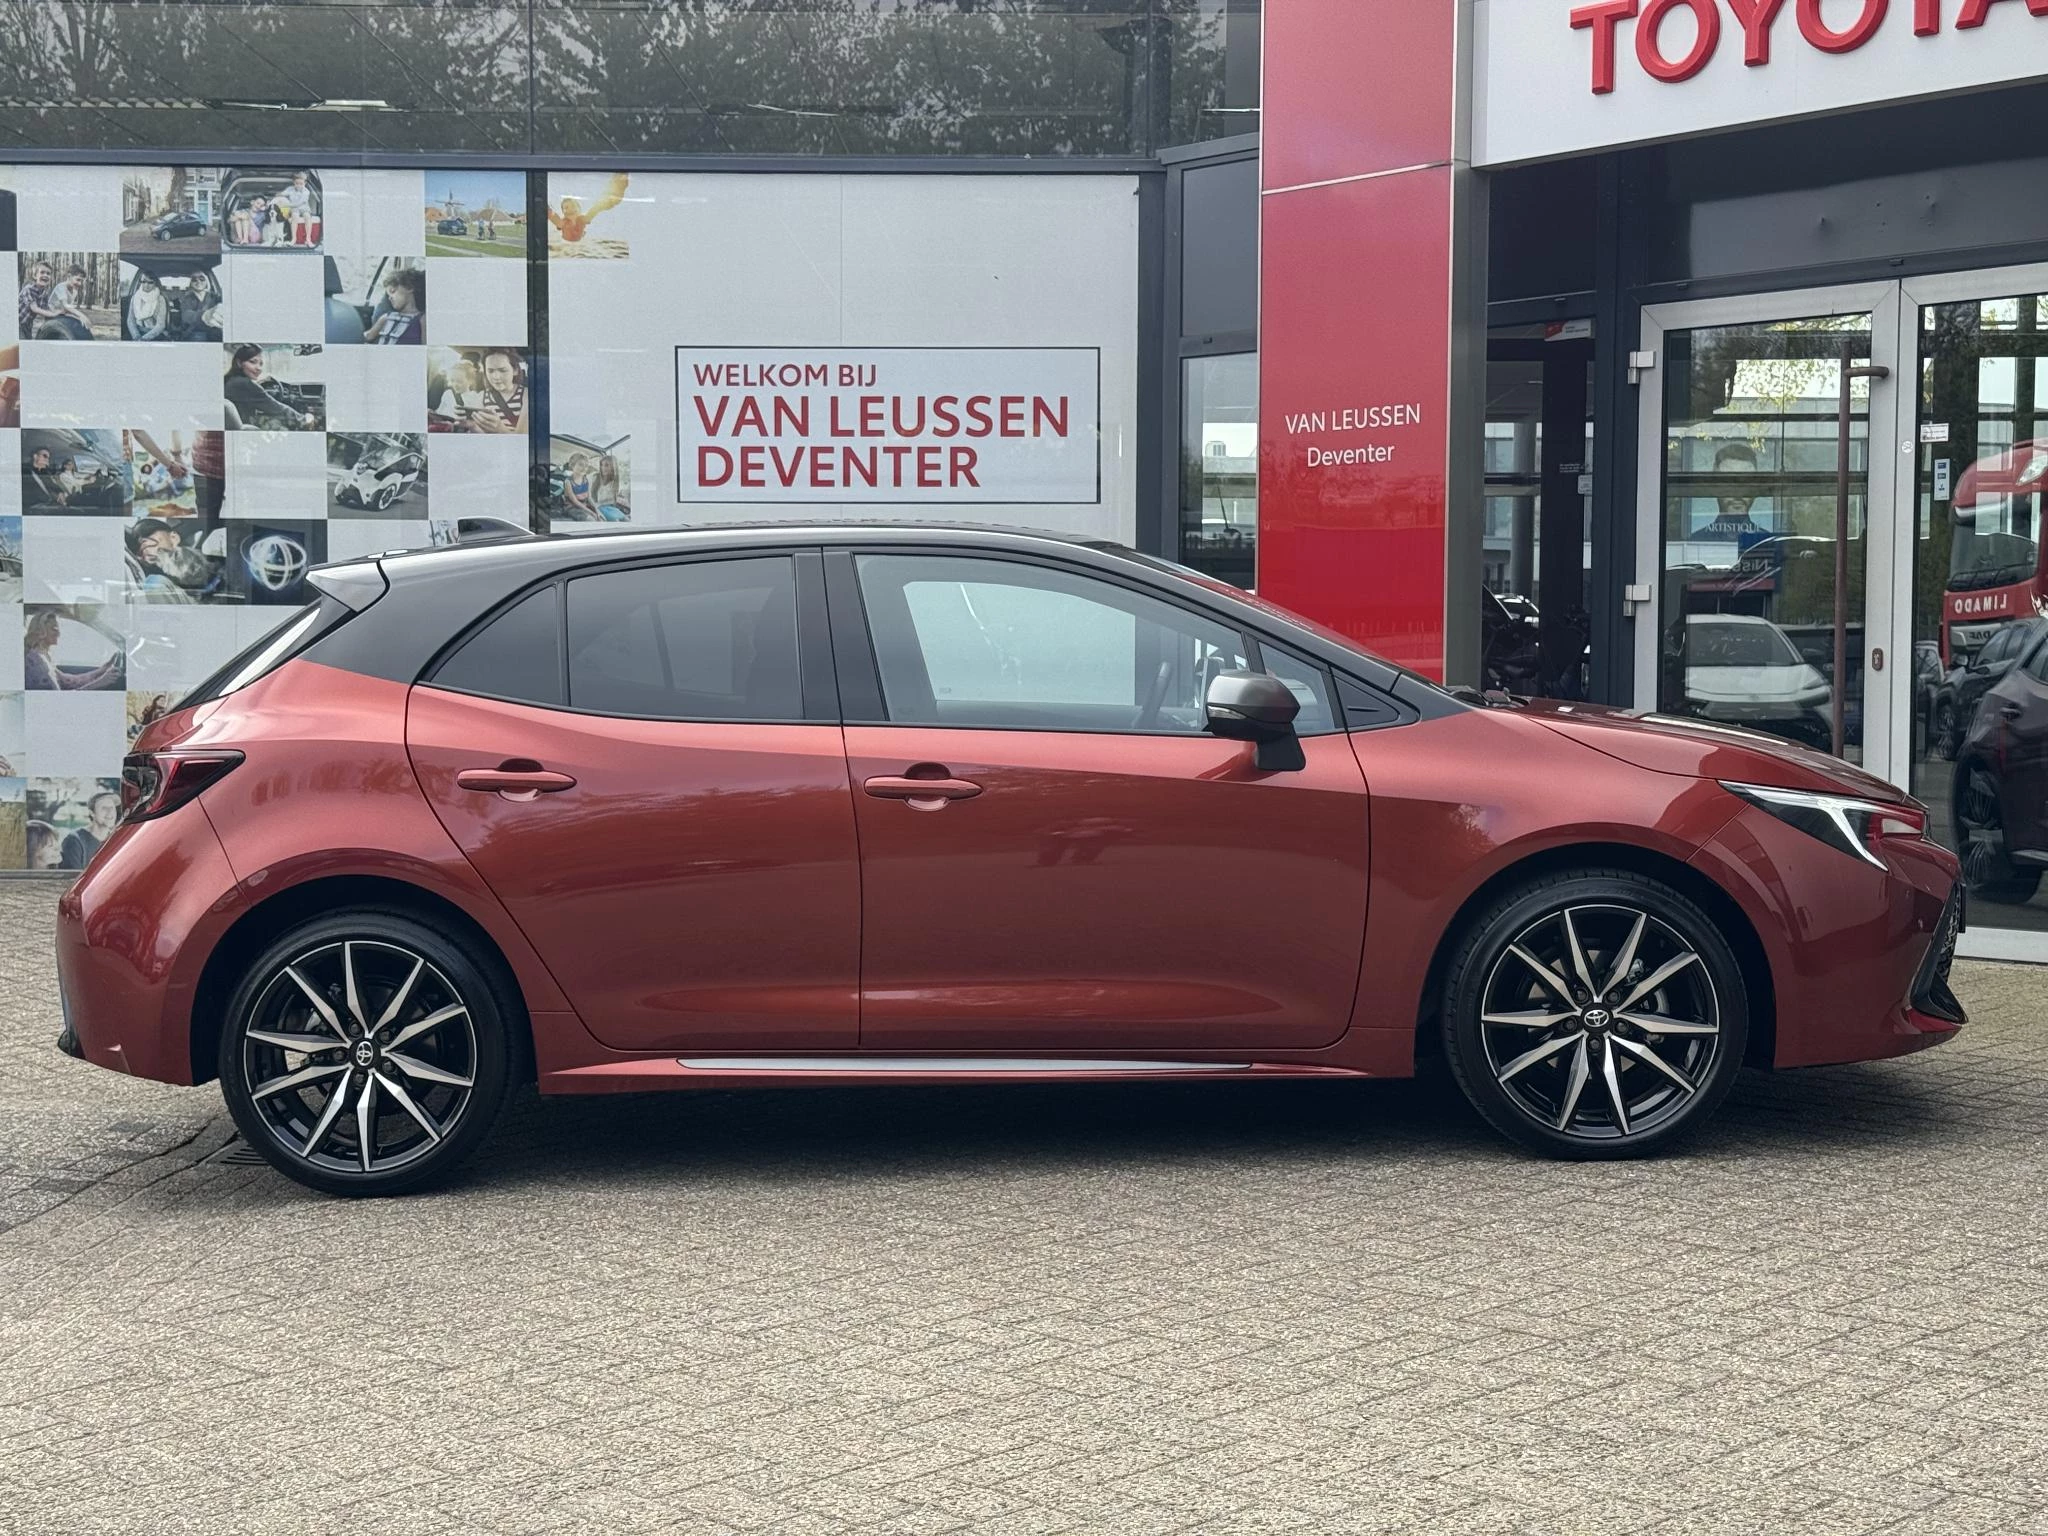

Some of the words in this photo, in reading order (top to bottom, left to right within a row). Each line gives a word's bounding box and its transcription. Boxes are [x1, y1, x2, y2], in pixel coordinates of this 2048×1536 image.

[693, 364, 828, 387] WELKOM
[838, 364, 877, 387] BIJ
[694, 396, 809, 437] VAN
[830, 395, 1069, 438] LEUSSEN
[1285, 411, 1325, 434] VAN
[1332, 403, 1420, 431] LEUSSEN
[697, 445, 981, 488] DEVENTER
[1307, 443, 1395, 467] Deventer
